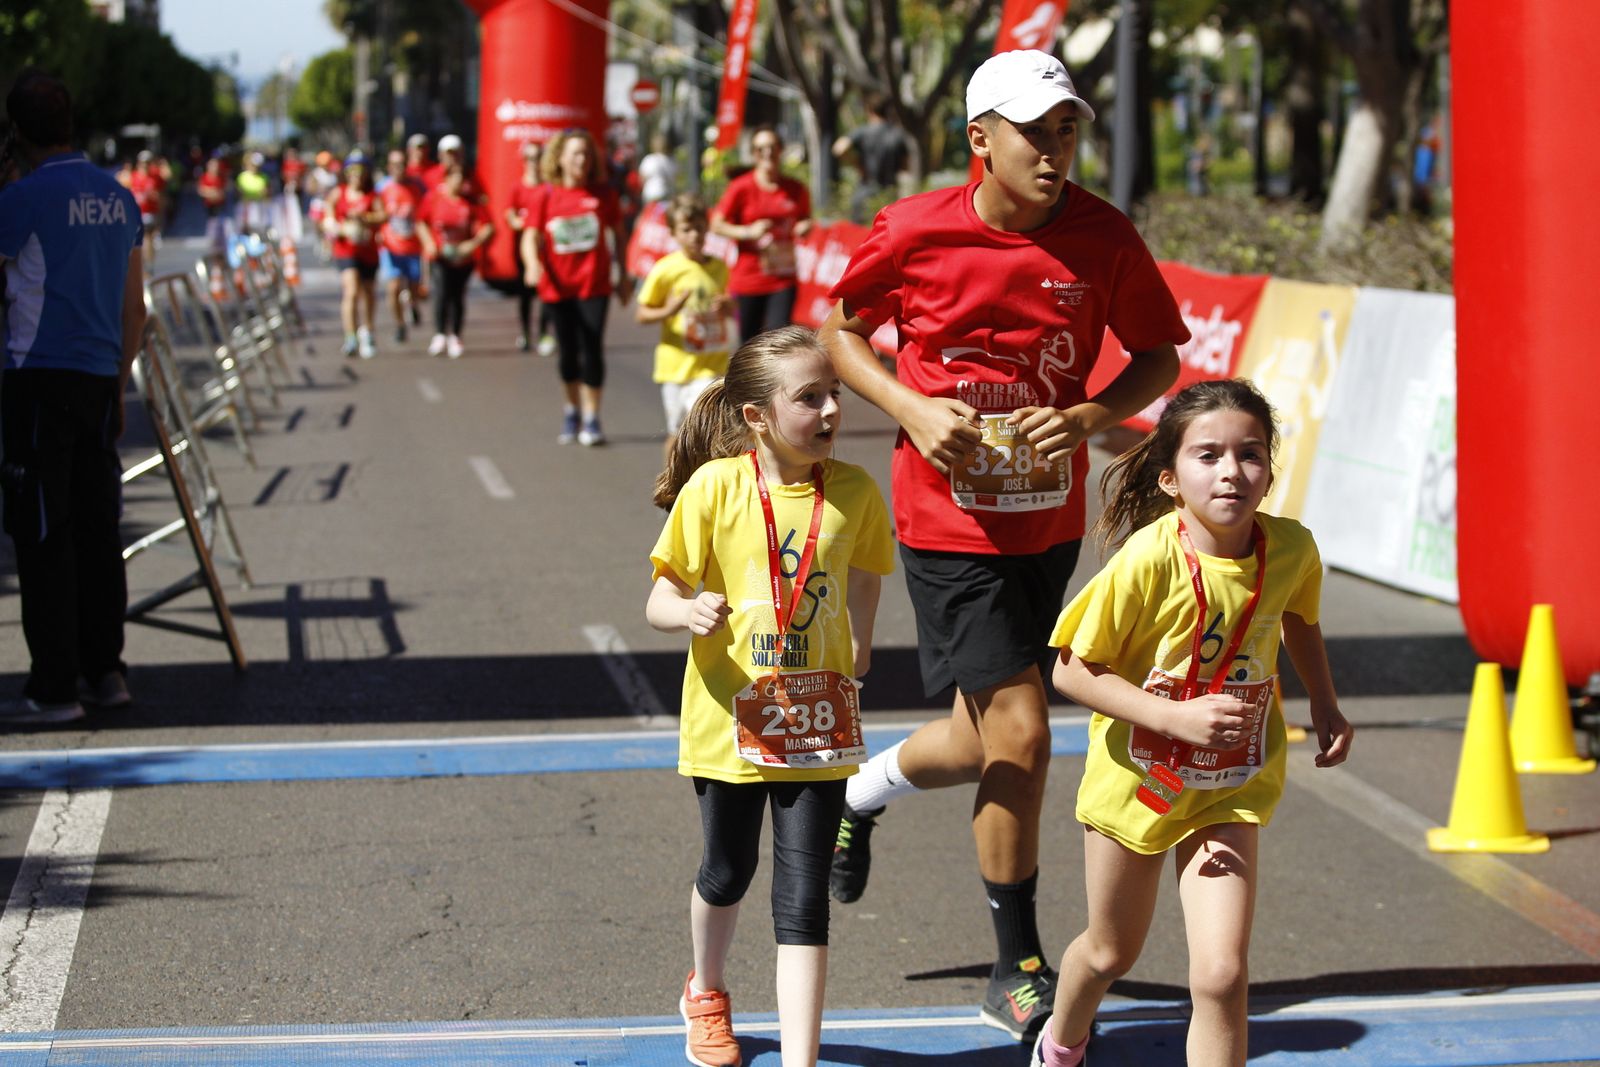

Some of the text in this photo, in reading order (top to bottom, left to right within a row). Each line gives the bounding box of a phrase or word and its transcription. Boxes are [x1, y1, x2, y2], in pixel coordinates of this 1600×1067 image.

[68, 194, 127, 227] NEXA
[956, 380, 1038, 399] CARRERA
[967, 444, 1053, 476] 3284
[1002, 475, 1033, 492] JOSÉ A.
[751, 650, 808, 668] SOLIARIA
[784, 673, 829, 687] CARRERA
[760, 700, 836, 736] 238
[784, 733, 832, 751] MARGARI
[1133, 747, 1153, 759] niños
[1192, 750, 1218, 767] MAR
